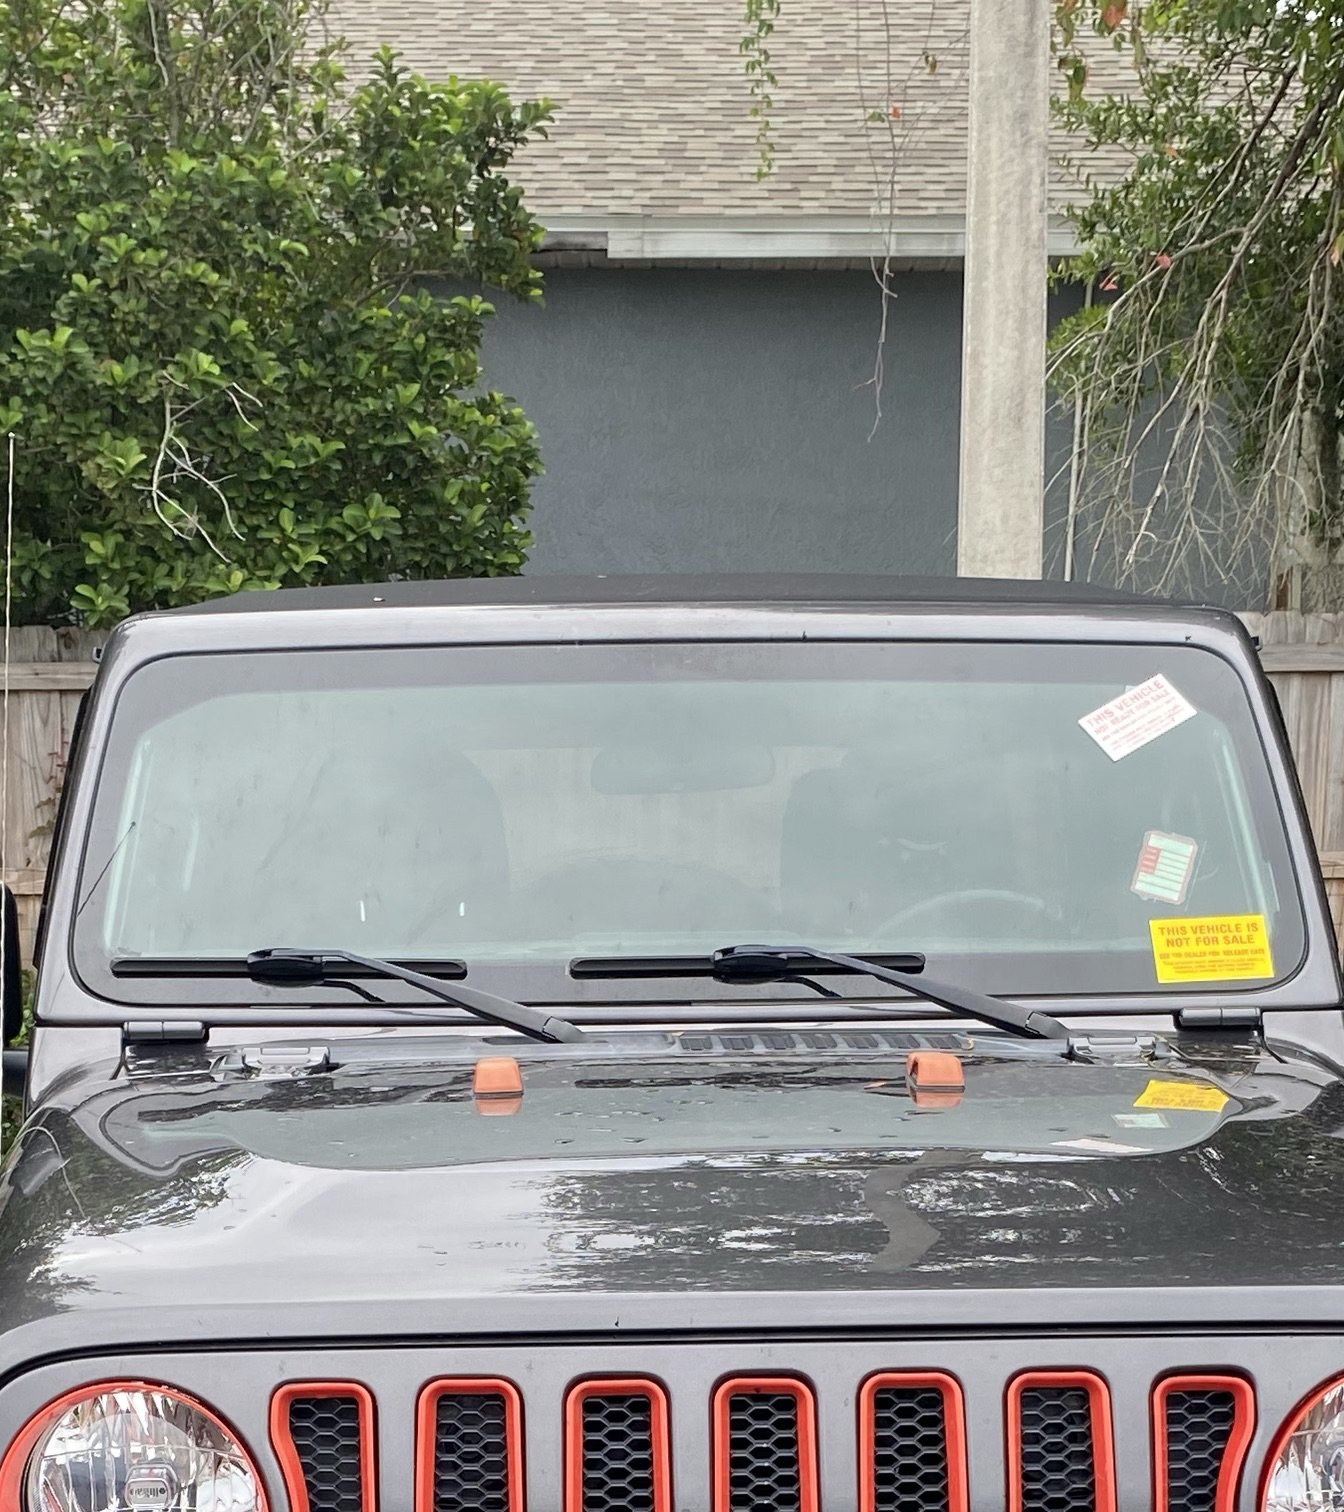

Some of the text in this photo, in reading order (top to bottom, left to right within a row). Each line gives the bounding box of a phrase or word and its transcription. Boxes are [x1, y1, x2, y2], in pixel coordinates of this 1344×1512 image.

[1087, 708, 1114, 727] THIS
[1115, 679, 1164, 711] VEHICLE
[1158, 922, 1259, 936] THIS VEHICLE IS
[1166, 934, 1255, 948] NOT FOR SALE
